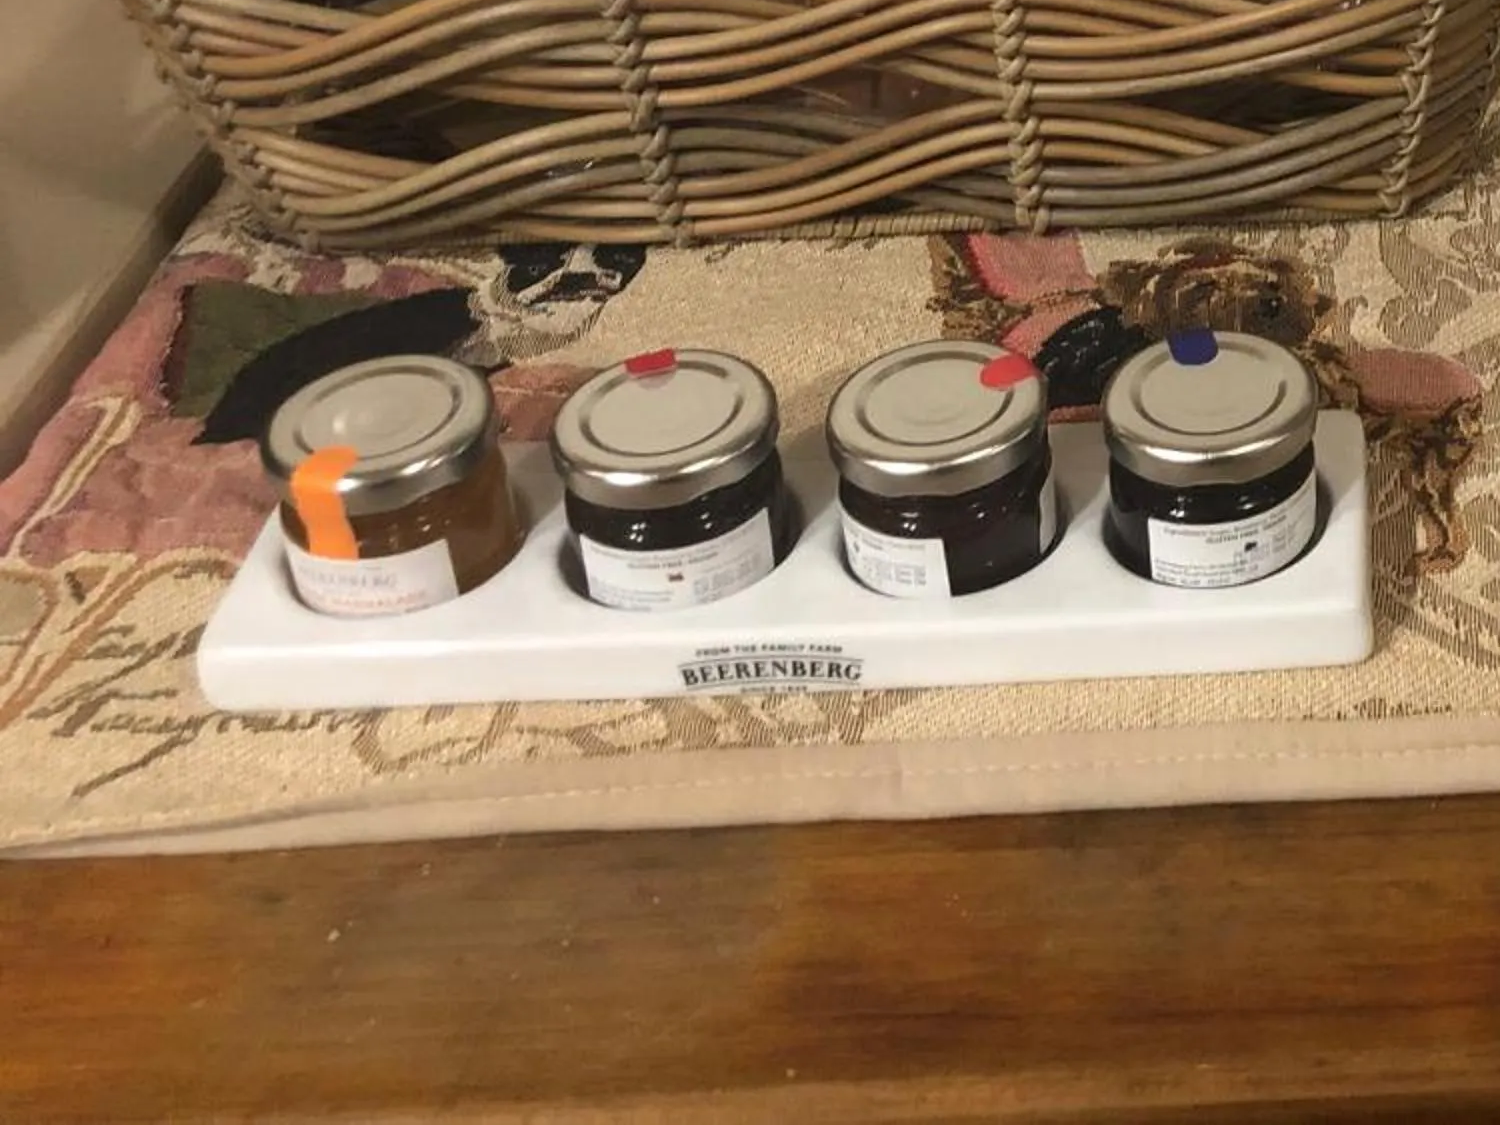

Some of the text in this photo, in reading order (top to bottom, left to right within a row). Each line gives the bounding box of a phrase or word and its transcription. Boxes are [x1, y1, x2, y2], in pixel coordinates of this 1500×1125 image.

[695, 646, 730, 657] FROM
[761, 643, 805, 653] FAMILY
[809, 644, 843, 654] FARM
[681, 659, 863, 687] BEERENBERG
